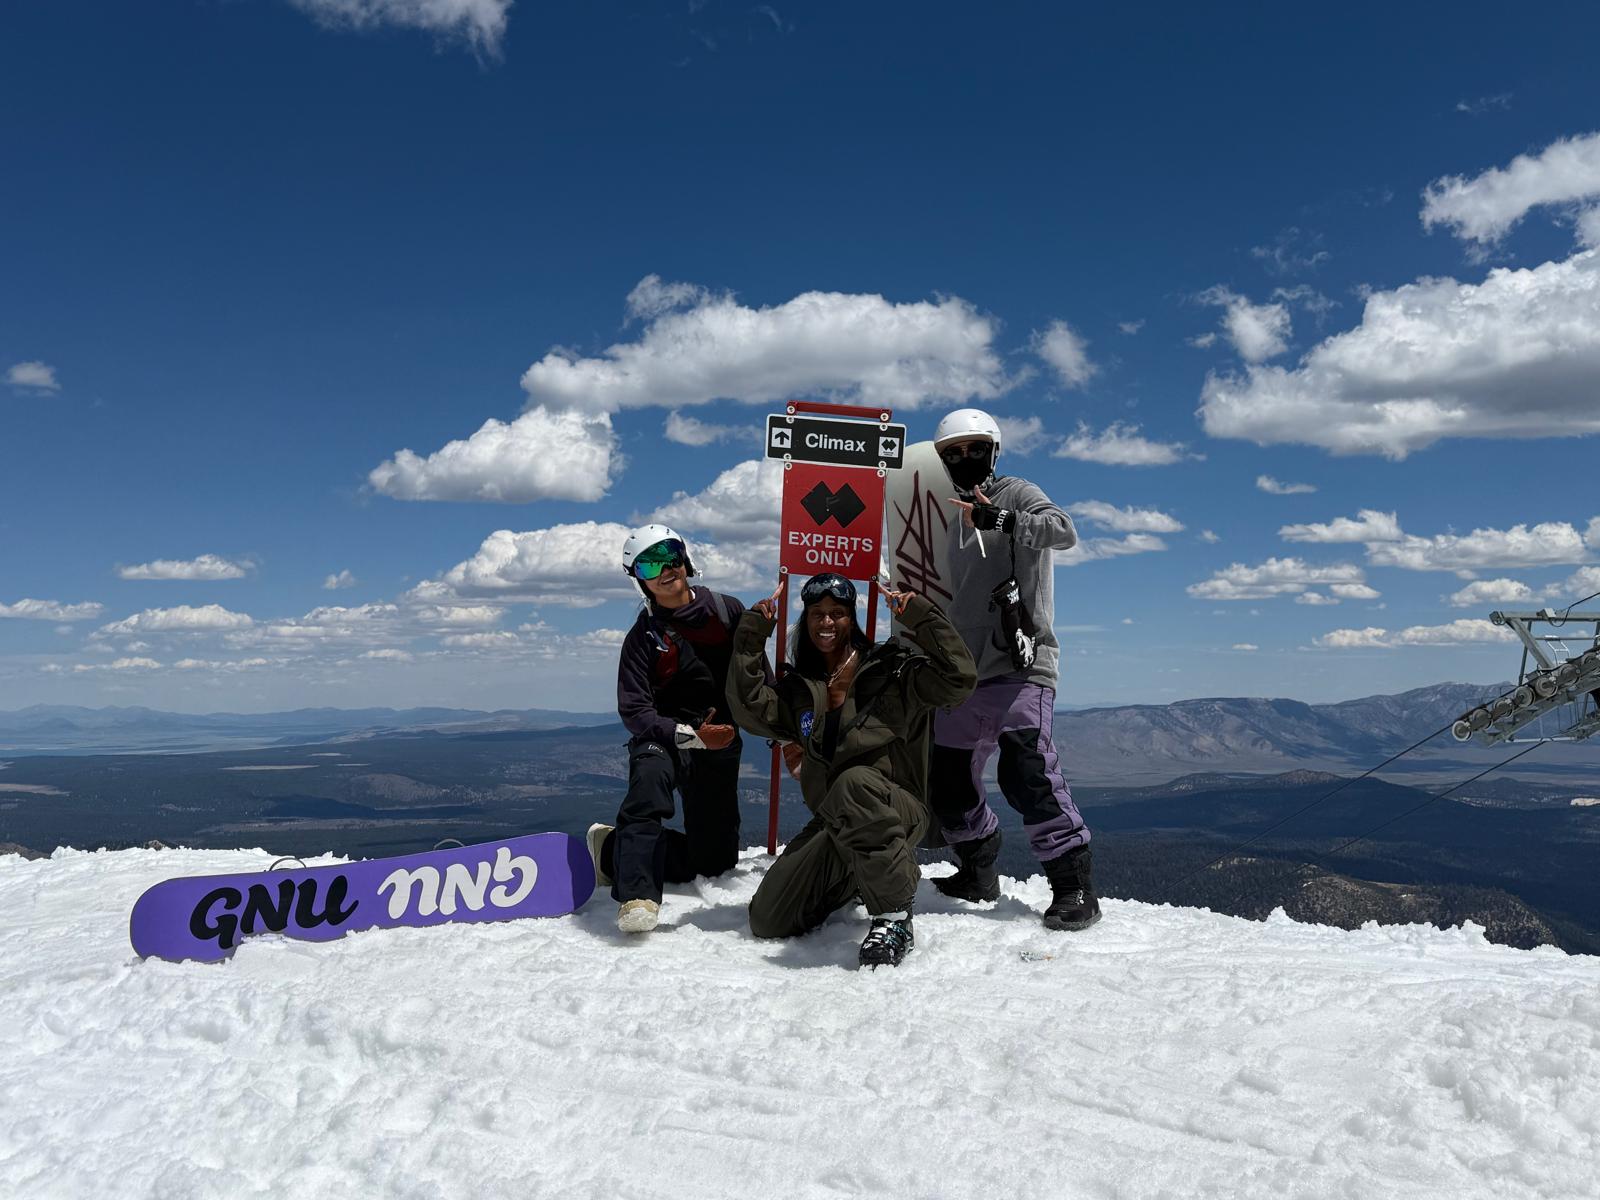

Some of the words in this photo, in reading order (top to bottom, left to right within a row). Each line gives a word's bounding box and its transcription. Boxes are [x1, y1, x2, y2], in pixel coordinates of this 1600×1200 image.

[805, 433, 866, 453] Climax
[788, 531, 873, 552] EXPERTS
[806, 549, 854, 567] ONLY
[377, 847, 538, 919] GNU
[189, 874, 359, 949] GNU
